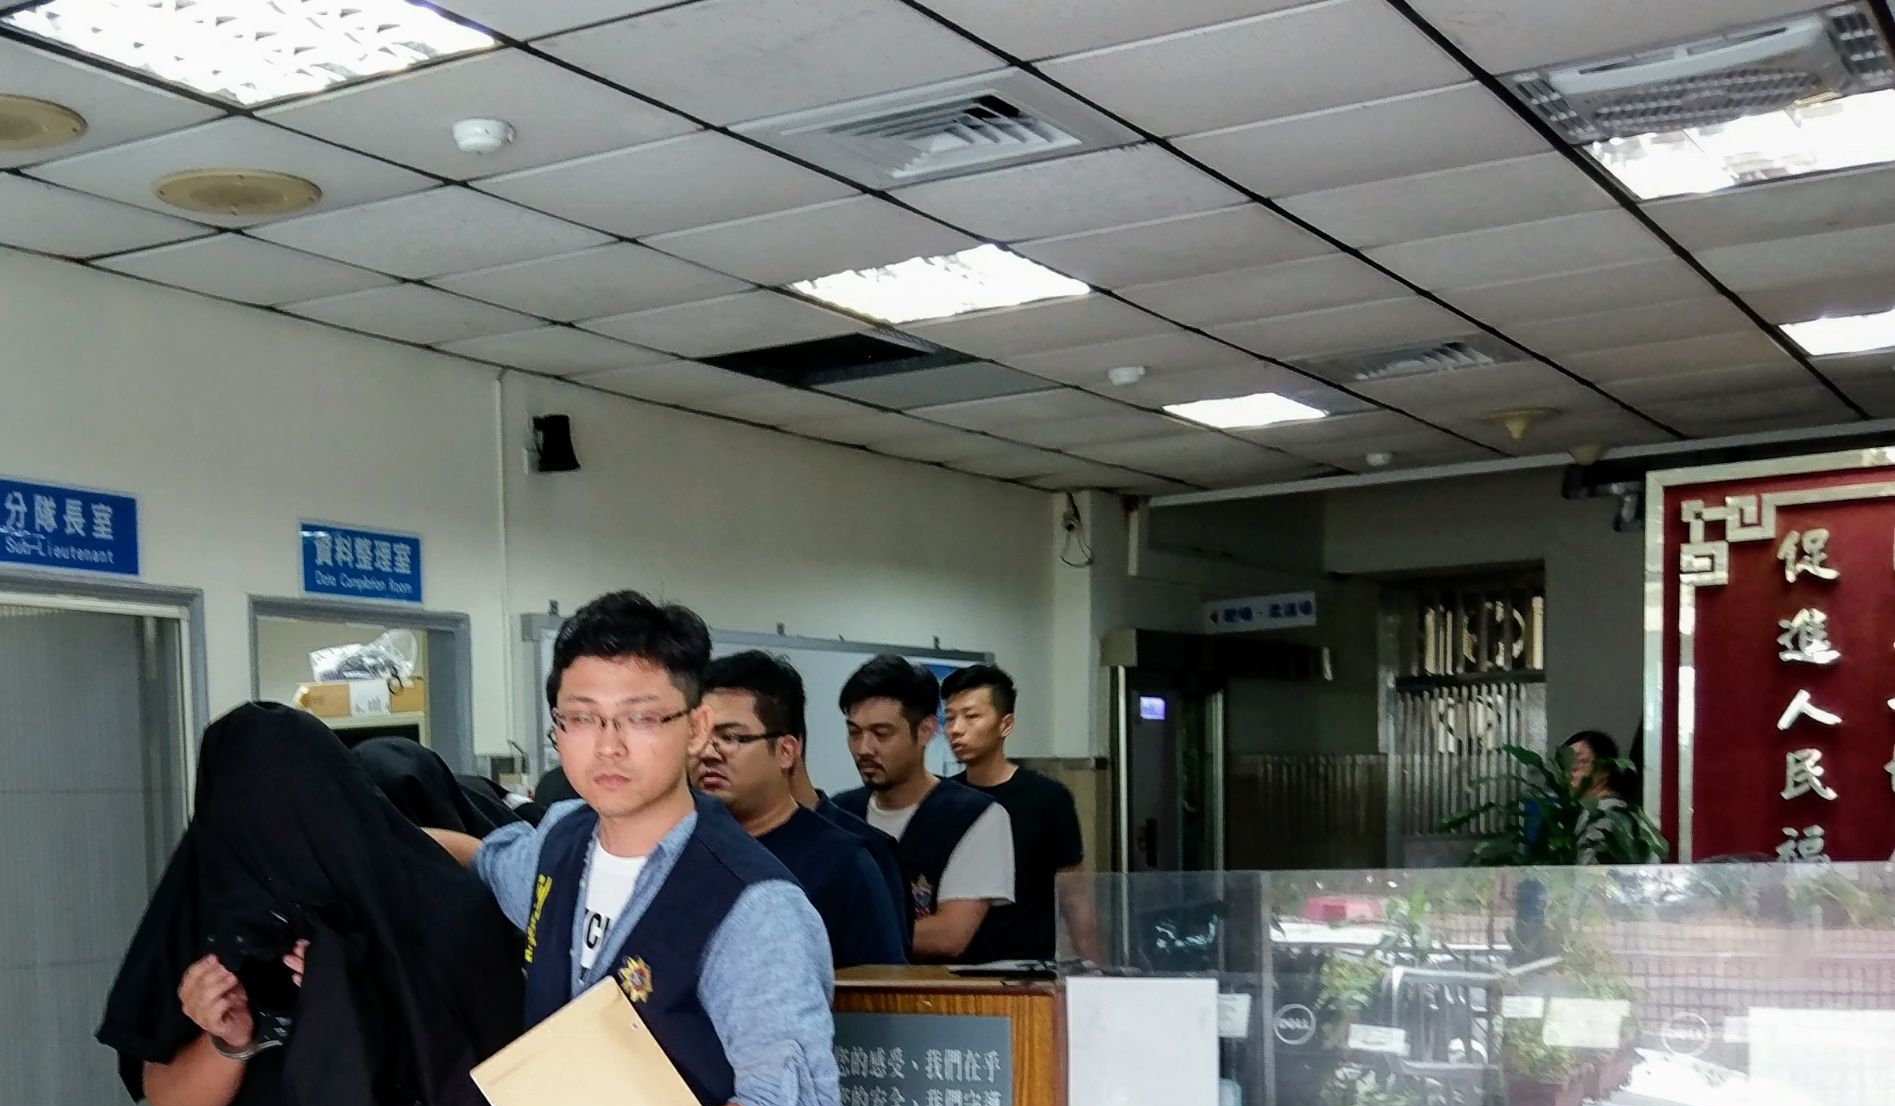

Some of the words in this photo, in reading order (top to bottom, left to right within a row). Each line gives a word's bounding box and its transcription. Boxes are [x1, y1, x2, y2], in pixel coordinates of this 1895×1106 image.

[4, 491, 114, 541] 分隊長室
[314, 533, 411, 575] 資料整理室
